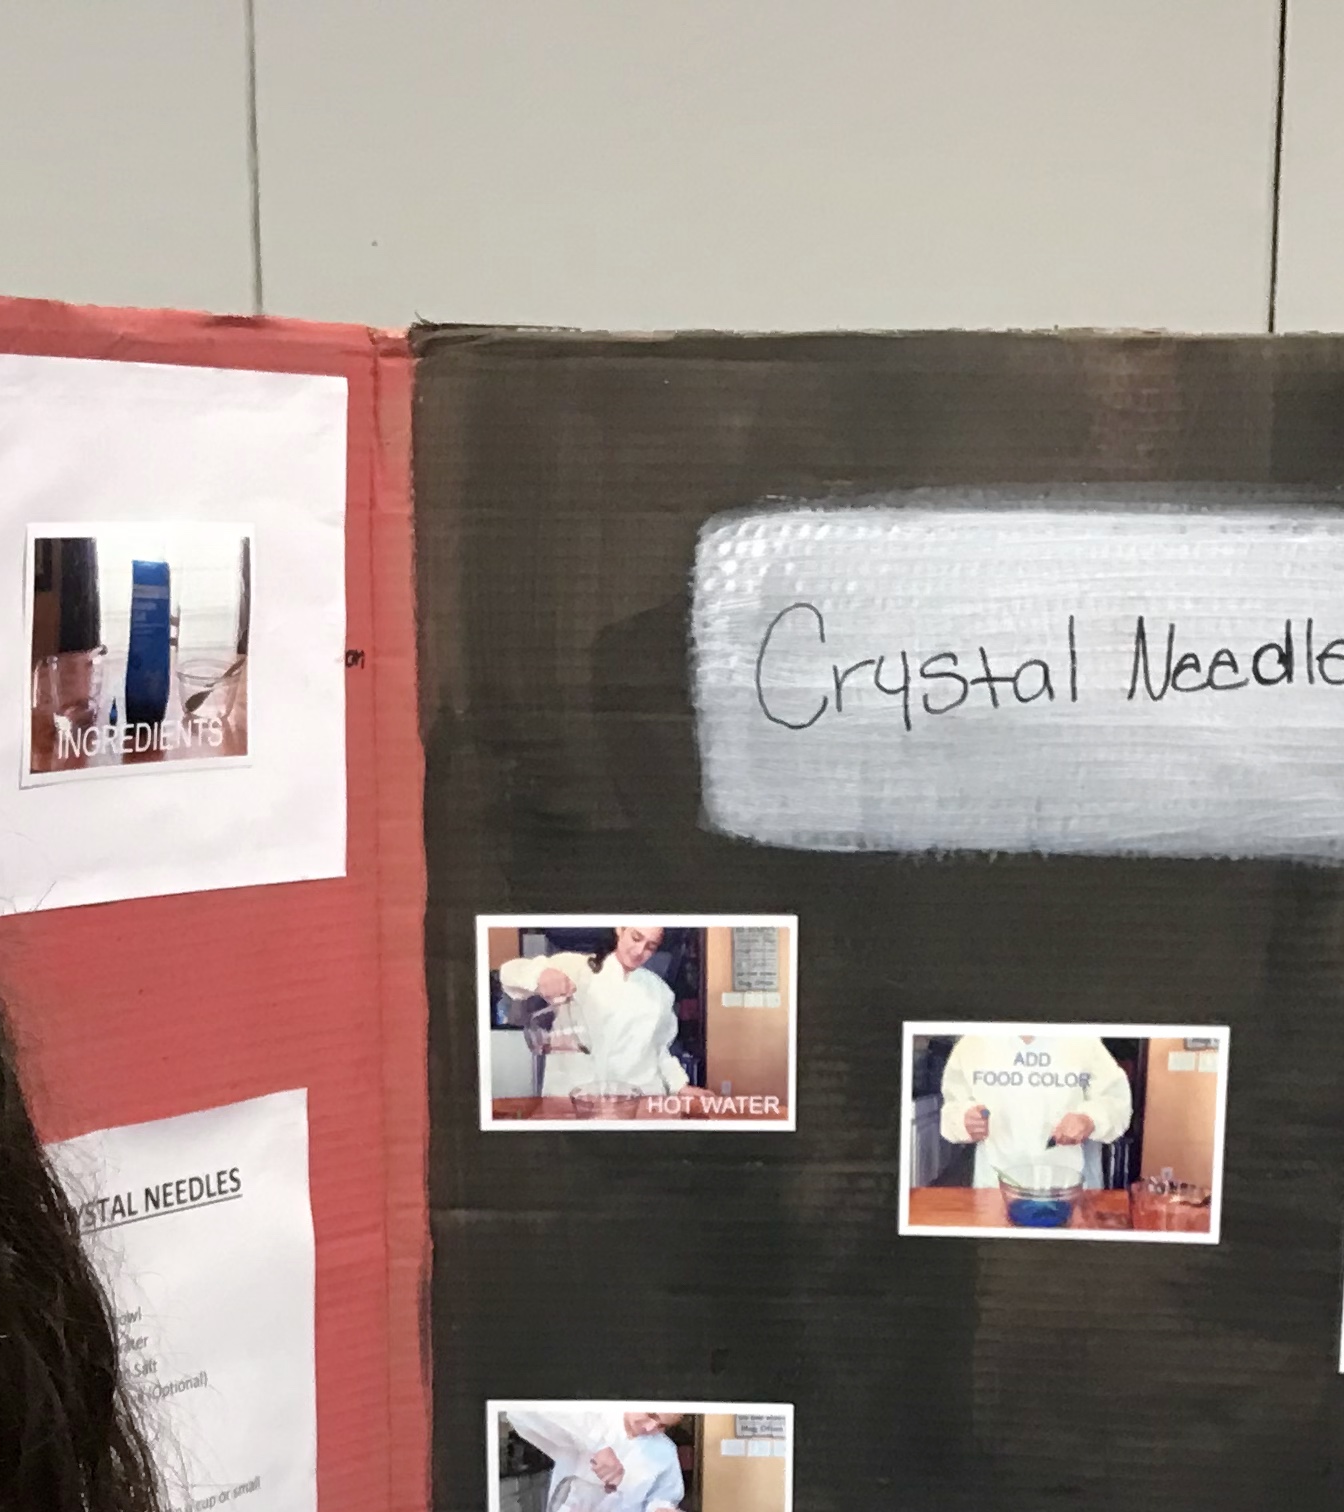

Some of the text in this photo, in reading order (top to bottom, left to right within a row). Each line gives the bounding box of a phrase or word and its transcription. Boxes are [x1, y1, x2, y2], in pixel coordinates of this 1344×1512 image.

[755, 602, 1078, 731] Crystal
[57, 718, 224, 760] INGREDIENTS
[1013, 1051, 1052, 1068] ADD
[972, 1070, 1092, 1089] FOOD COLOR
[647, 1095, 780, 1115] HOT WATER
[78, 1166, 242, 1227] STAL NEEDLES
[117, 1306, 142, 1326] owl
[133, 1359, 158, 1378] Salt
